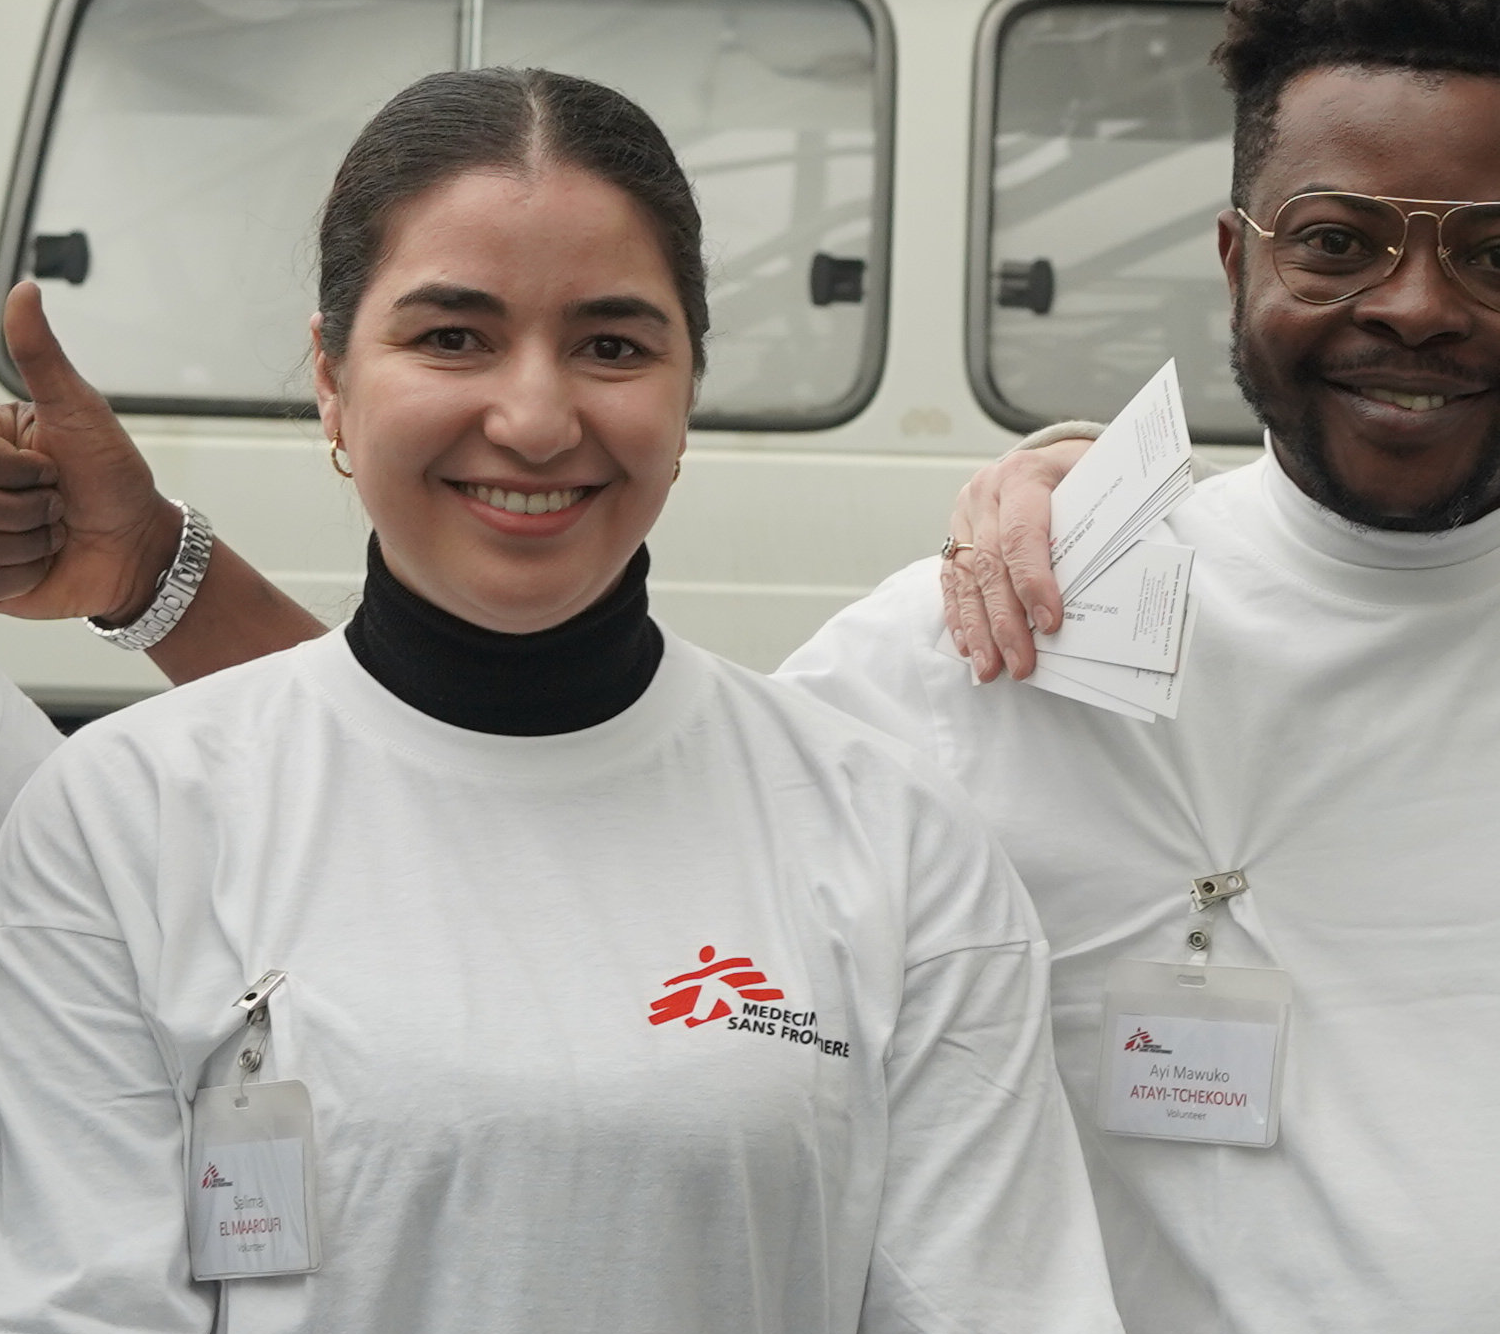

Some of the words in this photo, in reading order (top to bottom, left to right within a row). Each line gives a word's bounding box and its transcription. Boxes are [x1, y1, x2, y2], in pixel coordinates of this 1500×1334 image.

[742, 1002, 818, 1027] MEDECIN
[727, 1017, 776, 1036] SANS
[1149, 1064, 1170, 1081] Ayi
[1173, 1066, 1230, 1083] Mawuko
[1130, 1085, 1248, 1107] ATAYI-TCHEKOUVI
[1166, 1109, 1207, 1121] Volunteer
[233, 1195, 264, 1210] Salima
[220, 1221, 231, 1236] EL
[231, 1217, 281, 1236] MAAROUFI
